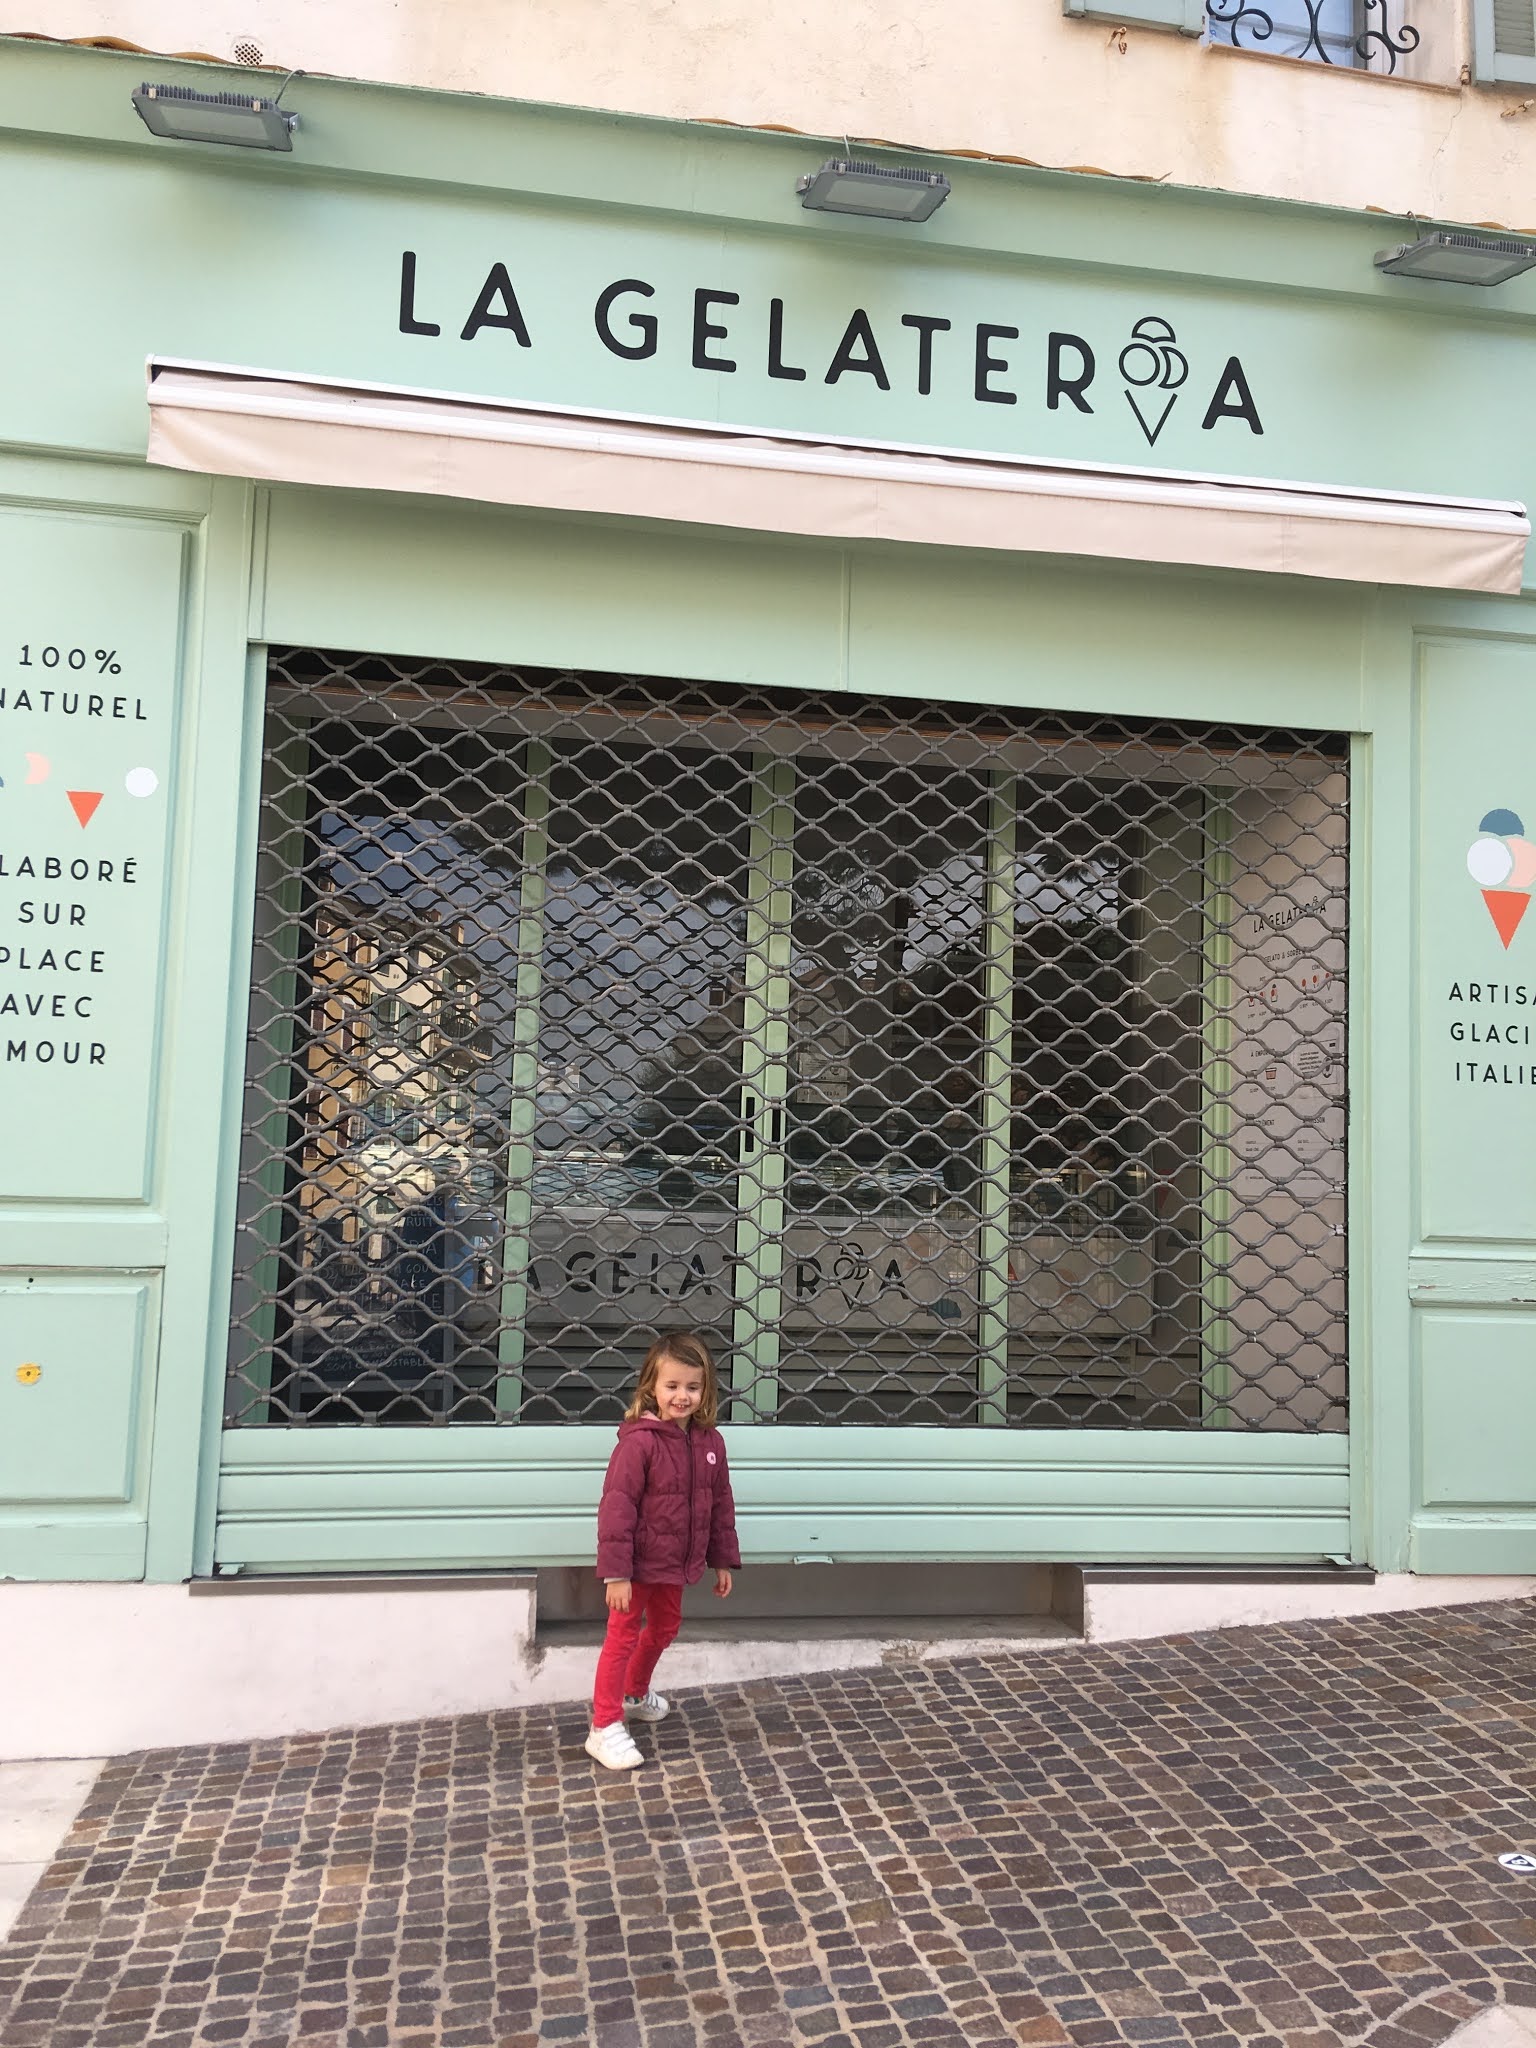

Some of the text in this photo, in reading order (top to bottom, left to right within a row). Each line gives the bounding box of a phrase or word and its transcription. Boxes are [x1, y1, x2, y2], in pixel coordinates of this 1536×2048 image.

[399, 251, 1264, 447] LA GELATERA
[18, 644, 122, 675] 100%
[0, 687, 147, 720] ATUREL
[0, 855, 137, 883] LABORÉ
[18, 901, 86, 926] SUR
[0, 993, 92, 1018] AVEC
[1449, 982, 1536, 1006] ARTIS
[1450, 1022, 1529, 1045] GLACI
[7, 1040, 105, 1065] MOUR
[1456, 1062, 1536, 1085] ITALIE
